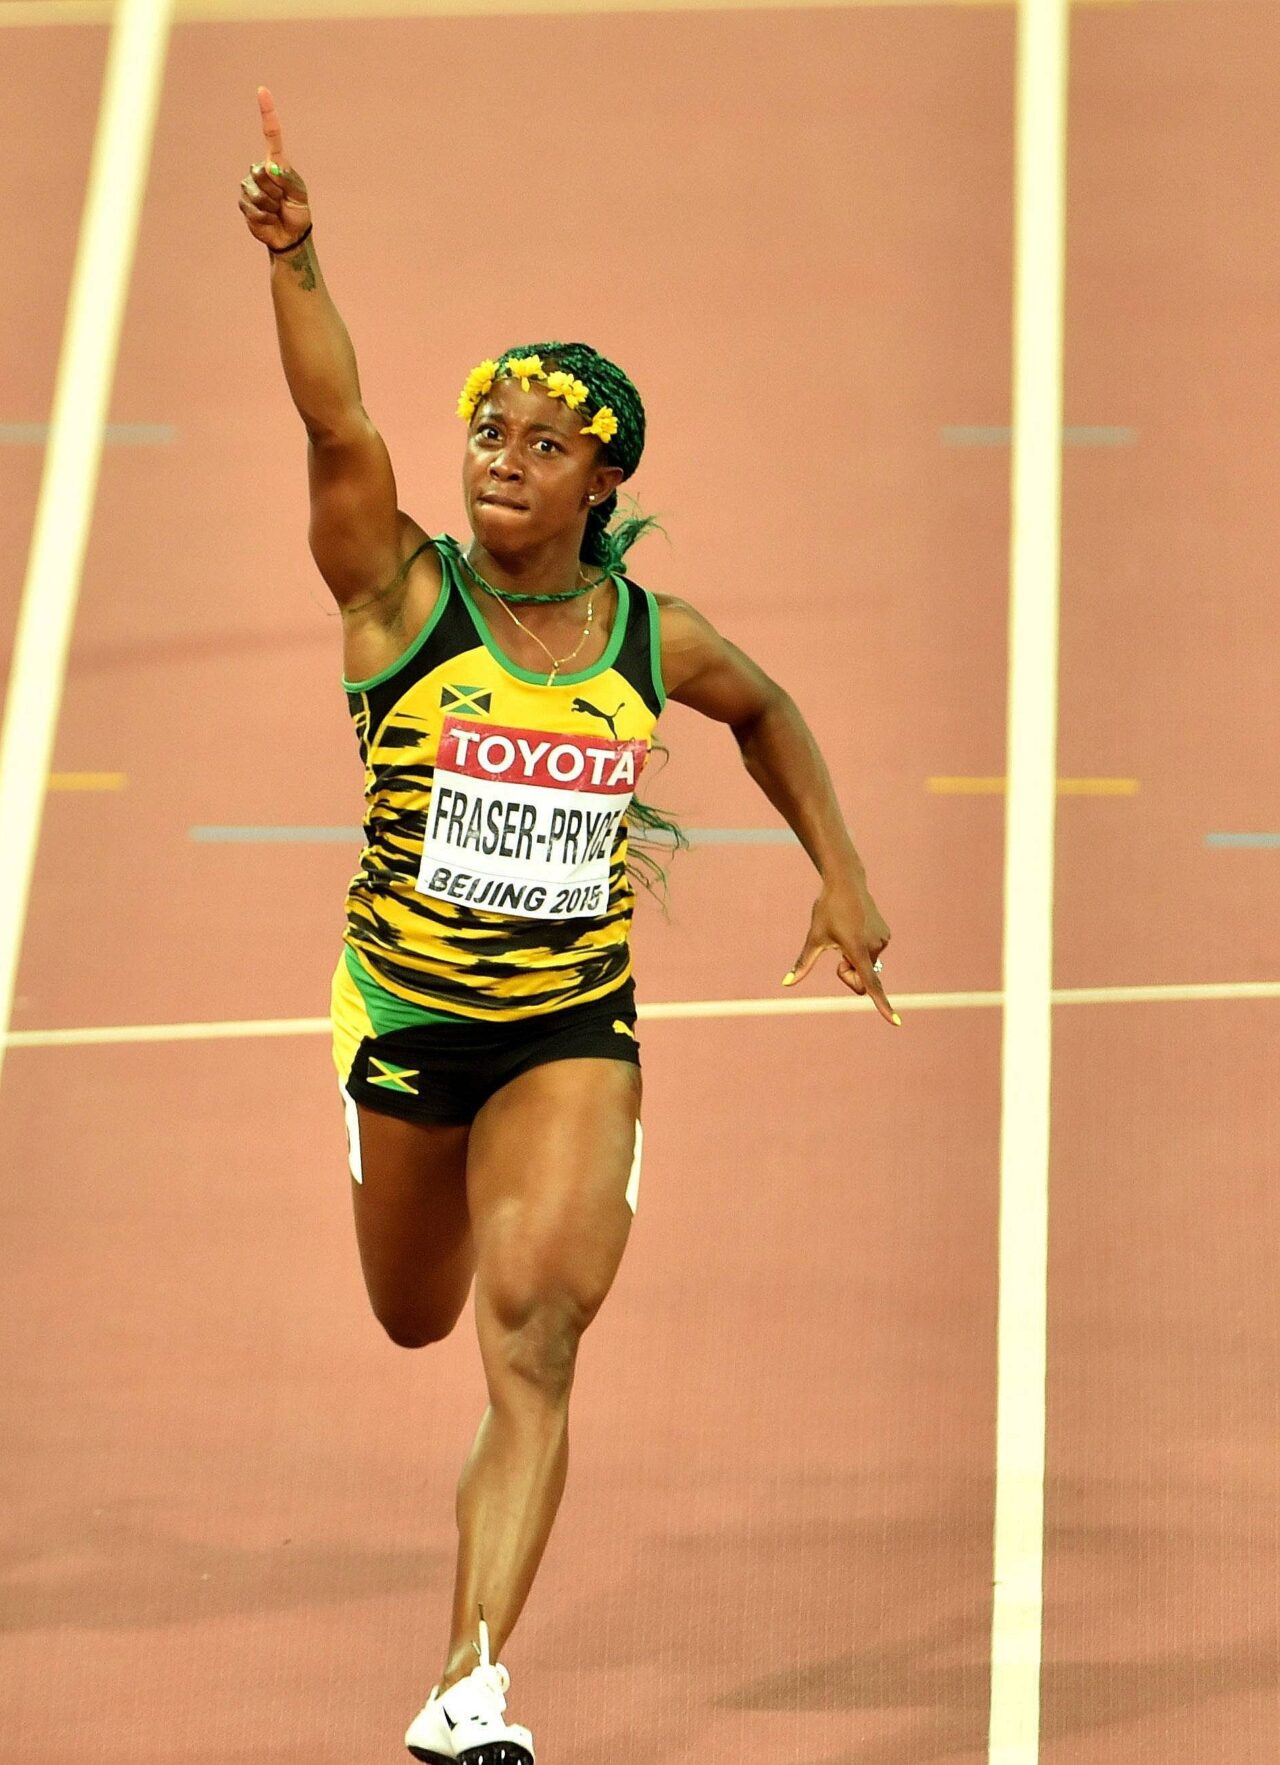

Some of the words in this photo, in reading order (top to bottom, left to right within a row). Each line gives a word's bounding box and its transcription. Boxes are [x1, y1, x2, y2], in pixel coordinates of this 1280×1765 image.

[449, 728, 635, 787] TOYOTA
[432, 787, 621, 865] FRASER-PRYCE
[428, 866, 547, 912] BEIJING
[549, 884, 604, 915] 2015
